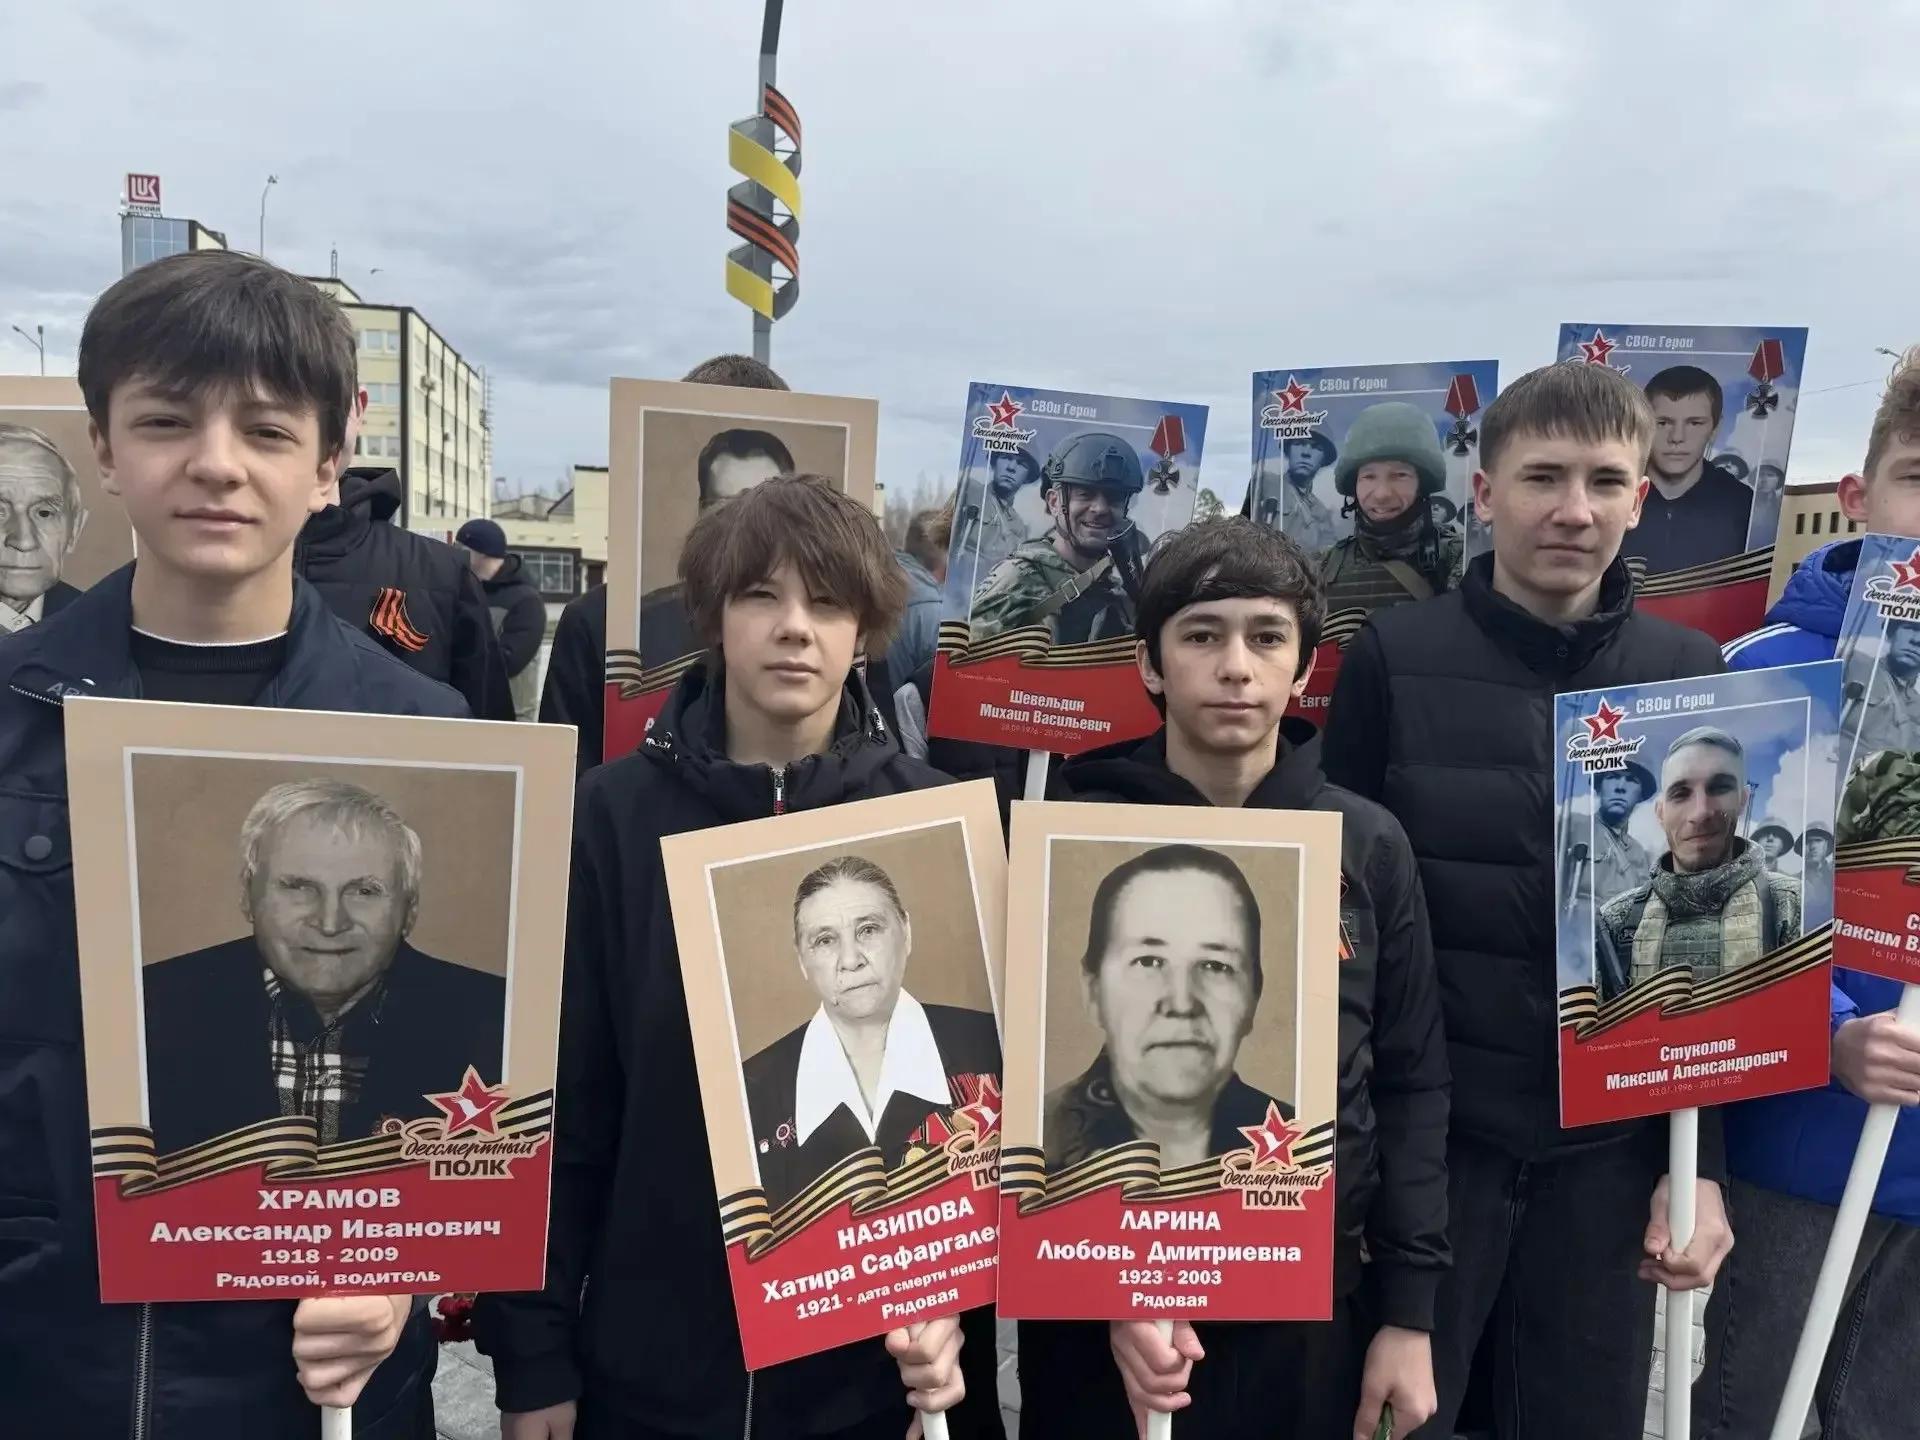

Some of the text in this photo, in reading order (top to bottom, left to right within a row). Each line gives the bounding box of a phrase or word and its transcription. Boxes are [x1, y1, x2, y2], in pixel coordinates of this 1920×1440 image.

[1659, 336, 1694, 350] Герои
[1353, 377, 1388, 391] Герои
[1064, 403, 1097, 418] Герои
[1276, 426, 1308, 438] ПОЛК
[985, 440, 1015, 451] ПОЛК
[1010, 689, 1085, 712] Шевельдин
[1300, 695, 1331, 707] Евге
[1675, 692, 1715, 710] Герои
[980, 703, 1111, 732] Михаил Васильевич
[1585, 757, 1623, 772] ПОЛК
[1907, 913, 1920, 930] С
[1660, 1038, 1736, 1062] Стуколов
[1606, 1049, 1788, 1091] Максим Александрович
[434, 1159, 506, 1176] ПОЛК
[258, 1187, 401, 1210] ХРАМОВ
[1246, 1189, 1300, 1206] ПОЛК
[837, 1196, 975, 1250] НАЗИПОВА
[1120, 1210, 1221, 1230] ЛАРИНА
[150, 1219, 502, 1244] Александр Иванович
[261, 1248, 320, 1265] 1918
[339, 1246, 399, 1263] 2009
[1036, 1239, 1301, 1265] Любовь Дмитриевна
[761, 1225, 1000, 1303] Хатира Сафаргале
[216, 1270, 441, 1288] Рядовой, водитель
[1119, 1270, 1163, 1285] 1923
[1177, 1269, 1222, 1285] 2003
[796, 1293, 843, 1319] 1921
[857, 1284, 891, 1304] дата
[894, 1269, 947, 1293] смерти
[1131, 1291, 1208, 1308] Рядовая
[881, 1288, 959, 1320] Рядовая
